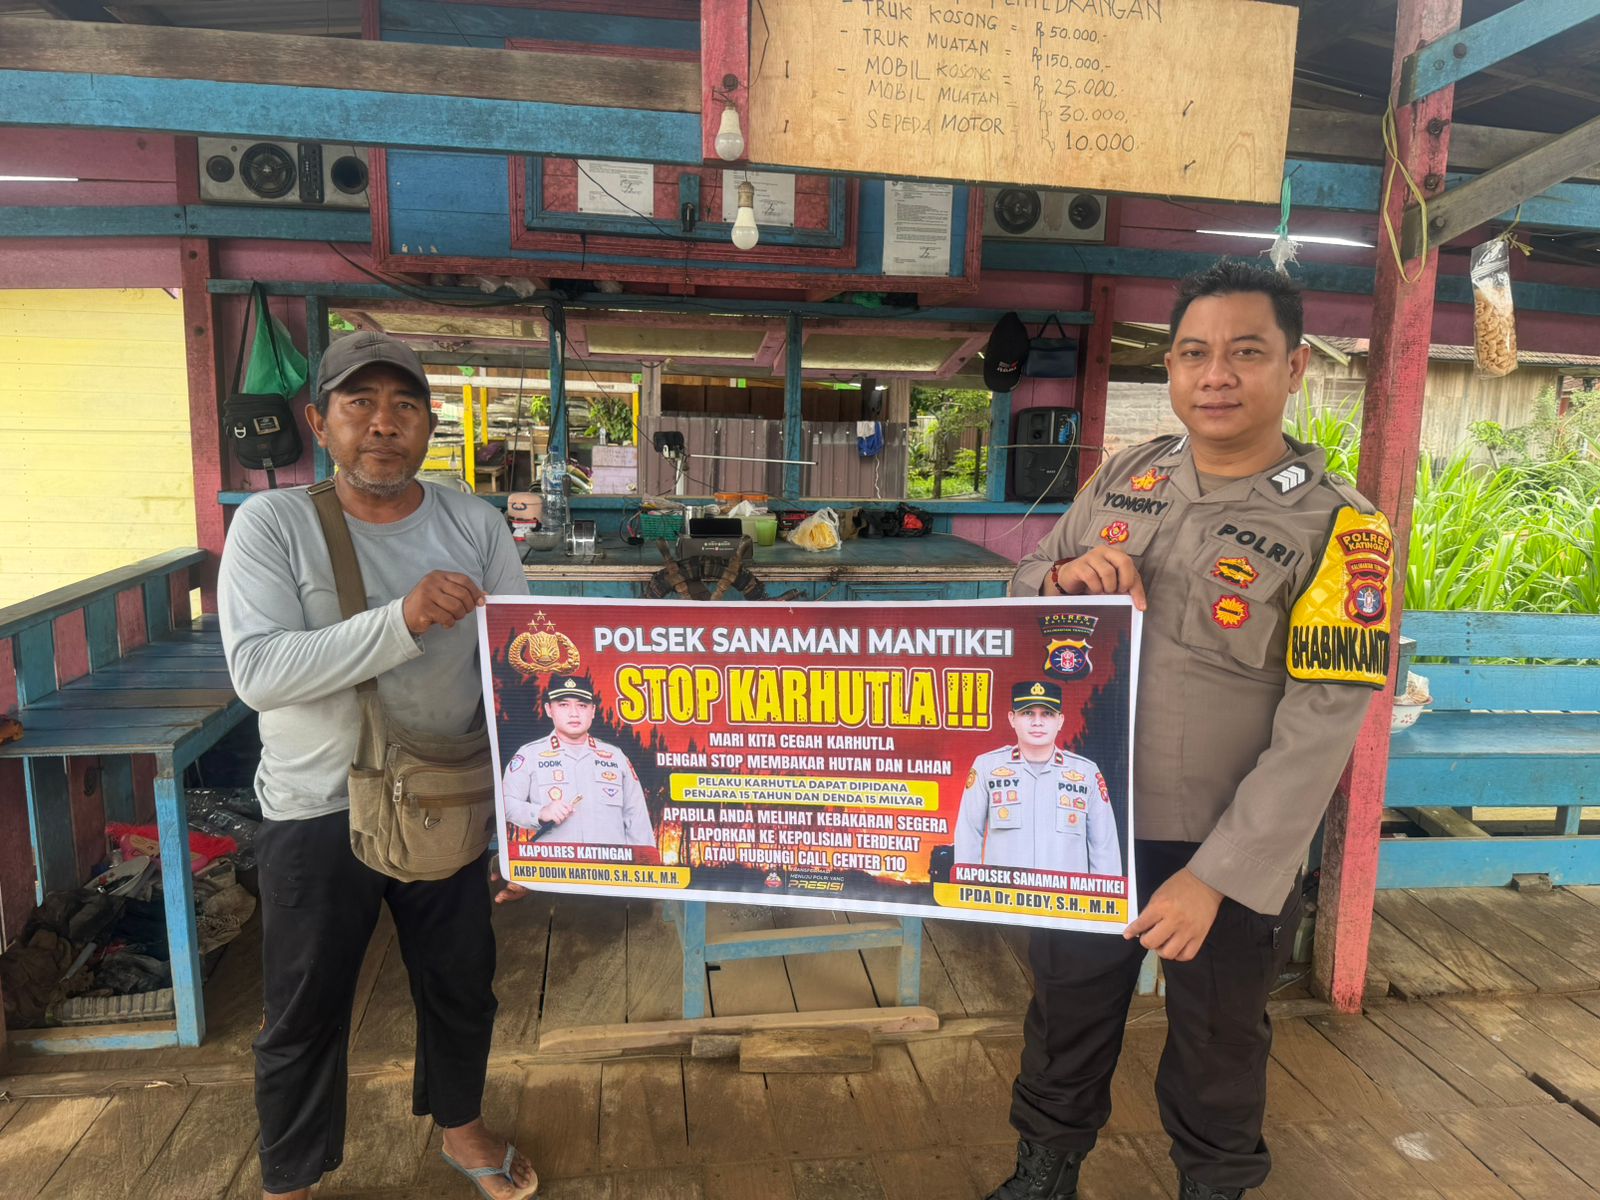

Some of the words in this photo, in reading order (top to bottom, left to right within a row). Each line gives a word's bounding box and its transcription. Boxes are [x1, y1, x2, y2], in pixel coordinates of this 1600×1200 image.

[862, 0, 912, 21] TRUK
[929, 4, 998, 30] KOSONG
[863, 28, 909, 48] TRUK
[927, 32, 989, 56] MUATAN
[865, 56, 930, 80] MOBIL
[868, 80, 926, 103] MOBIL
[938, 87, 999, 105] MUATAN
[866, 109, 932, 135] SEPEDA
[940, 114, 1005, 135] MOTOR
[1102, 492, 1168, 517] YONGKY
[1217, 523, 1296, 567] POLRI
[1343, 532, 1390, 549] POLRES
[1348, 542, 1388, 555] KATINGAN
[594, 626, 706, 653] POLSEK
[712, 627, 859, 654] SANAMAN
[868, 628, 1013, 656] MANTIKEI
[616, 666, 721, 722] STOP
[728, 668, 939, 726] KARHUTLA
[946, 671, 990, 728] !!!
[709, 732, 744, 747] MARI
[748, 733, 776, 748] KITA
[780, 734, 823, 749] CEGAH
[826, 735, 895, 751] KARHUTLA
[538, 760, 562, 768] DODIK
[594, 760, 619, 768] POLRI
[656, 752, 707, 767] DENGAN
[711, 753, 743, 768] STOP
[747, 755, 825, 770] MEMBAKAR
[829, 757, 872, 772] HUTAN
[875, 758, 903, 773] DAN
[907, 759, 952, 775] LAHAN
[698, 777, 741, 787] PELAKU
[744, 778, 806, 788] KARHUTLA
[808, 780, 847, 790] DAPAT
[849, 781, 908, 793] DIPIDANA
[988, 779, 1020, 789] DEDY
[1058, 782, 1088, 795] POLRI
[684, 789, 737, 799] PENJARA
[740, 790, 750, 799] 15
[752, 791, 792, 800] TAHUN
[795, 792, 820, 801] DAN
[822, 793, 863, 803] DENDA
[865, 794, 876, 804] 15
[879, 795, 924, 806] MILYAR
[663, 807, 715, 822] APABILA
[719, 808, 754, 823] ANDA
[757, 809, 813, 825] MELIHAT
[816, 812, 894, 830] KEBAKARAN
[897, 815, 948, 833] SEGERA
[690, 827, 756, 842] LAPORKAN
[759, 829, 775, 844] KE
[779, 830, 852, 847] KEPOLISIAN
[855, 834, 920, 852] TERDEKAT
[519, 844, 575, 859] KAPOLRES
[577, 846, 633, 861] KATINGAN
[704, 847, 736, 861] ATAU
[739, 848, 795, 864] HUBUNGI
[798, 851, 830, 867] CALL
[832, 852, 881, 870] CENTER
[884, 855, 906, 872] 110
[514, 865, 537, 878] AKBP
[539, 866, 567, 879] DODIK
[568, 867, 613, 882] HARTONO,
[660, 871, 680, 885] M.H.
[788, 879, 845, 892] PRESISI
[956, 867, 1011, 884] KAPOLSEK
[1013, 871, 1068, 890] SANAMAN
[1070, 876, 1125, 895] MANTIKEI
[960, 887, 992, 904] IPDA
[995, 890, 1013, 906] Dr.
[1016, 892, 1054, 911] DEDY,
[1056, 896, 1086, 913] S.H.,
[1089, 900, 1120, 915] M.H.
